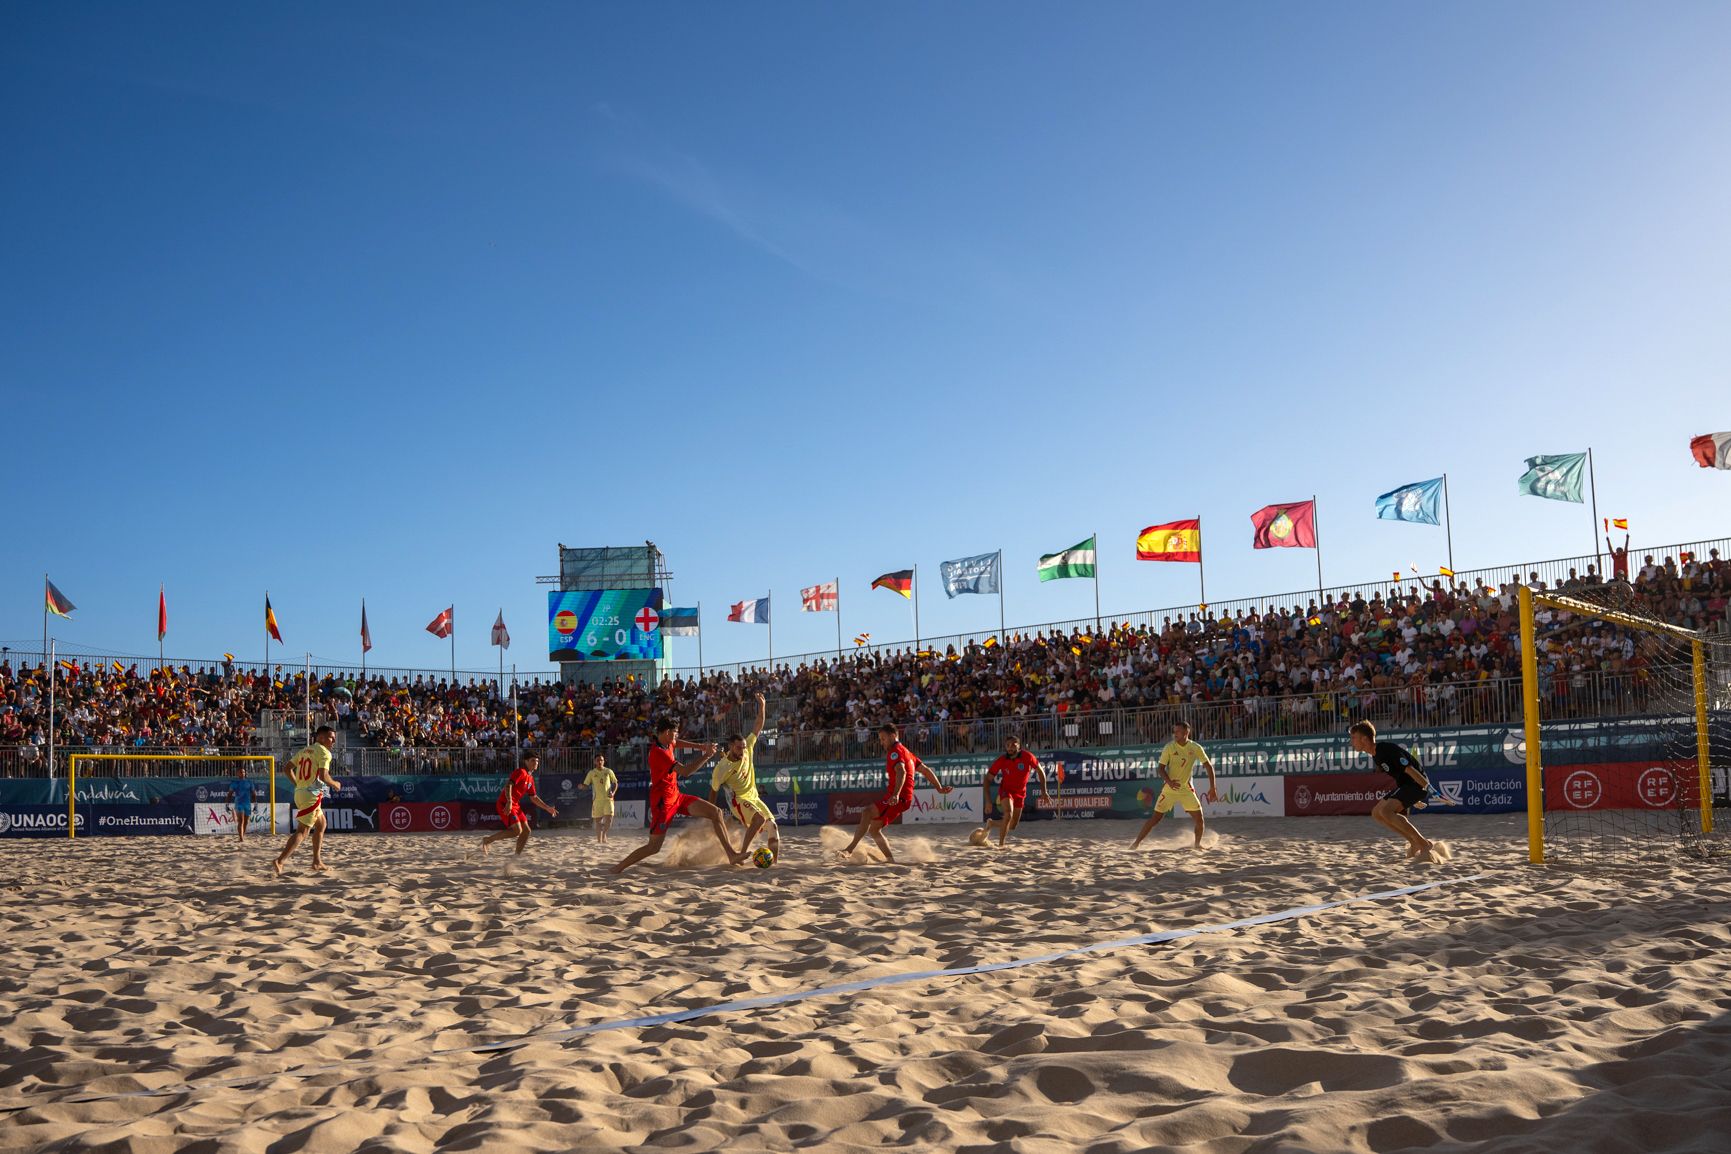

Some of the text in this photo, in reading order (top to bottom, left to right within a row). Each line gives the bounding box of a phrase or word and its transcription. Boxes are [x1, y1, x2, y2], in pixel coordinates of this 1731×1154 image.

[591, 616, 620, 626] 02:25
[586, 631, 598, 646] 6
[615, 628, 626, 645] 0
[298, 756, 313, 781] 10
[812, 770, 837, 790] FIFA
[840, 768, 883, 789] BEACH
[1081, 757, 1163, 781] EUROPEA
[1193, 749, 1270, 776] ALIFIER
[1180, 758, 1187, 768] 7
[1466, 778, 1522, 792] Diputación
[911, 792, 974, 814] Andalucía
[1074, 796, 1110, 808] QUALIFIER
[1314, 791, 1364, 804] Ayuntamiento
[1364, 790, 1375, 800] de
[1467, 794, 1513, 806] de Cádiz
[11, 813, 68, 828] UNAOC
[98, 815, 187, 828] #OneHumanity
